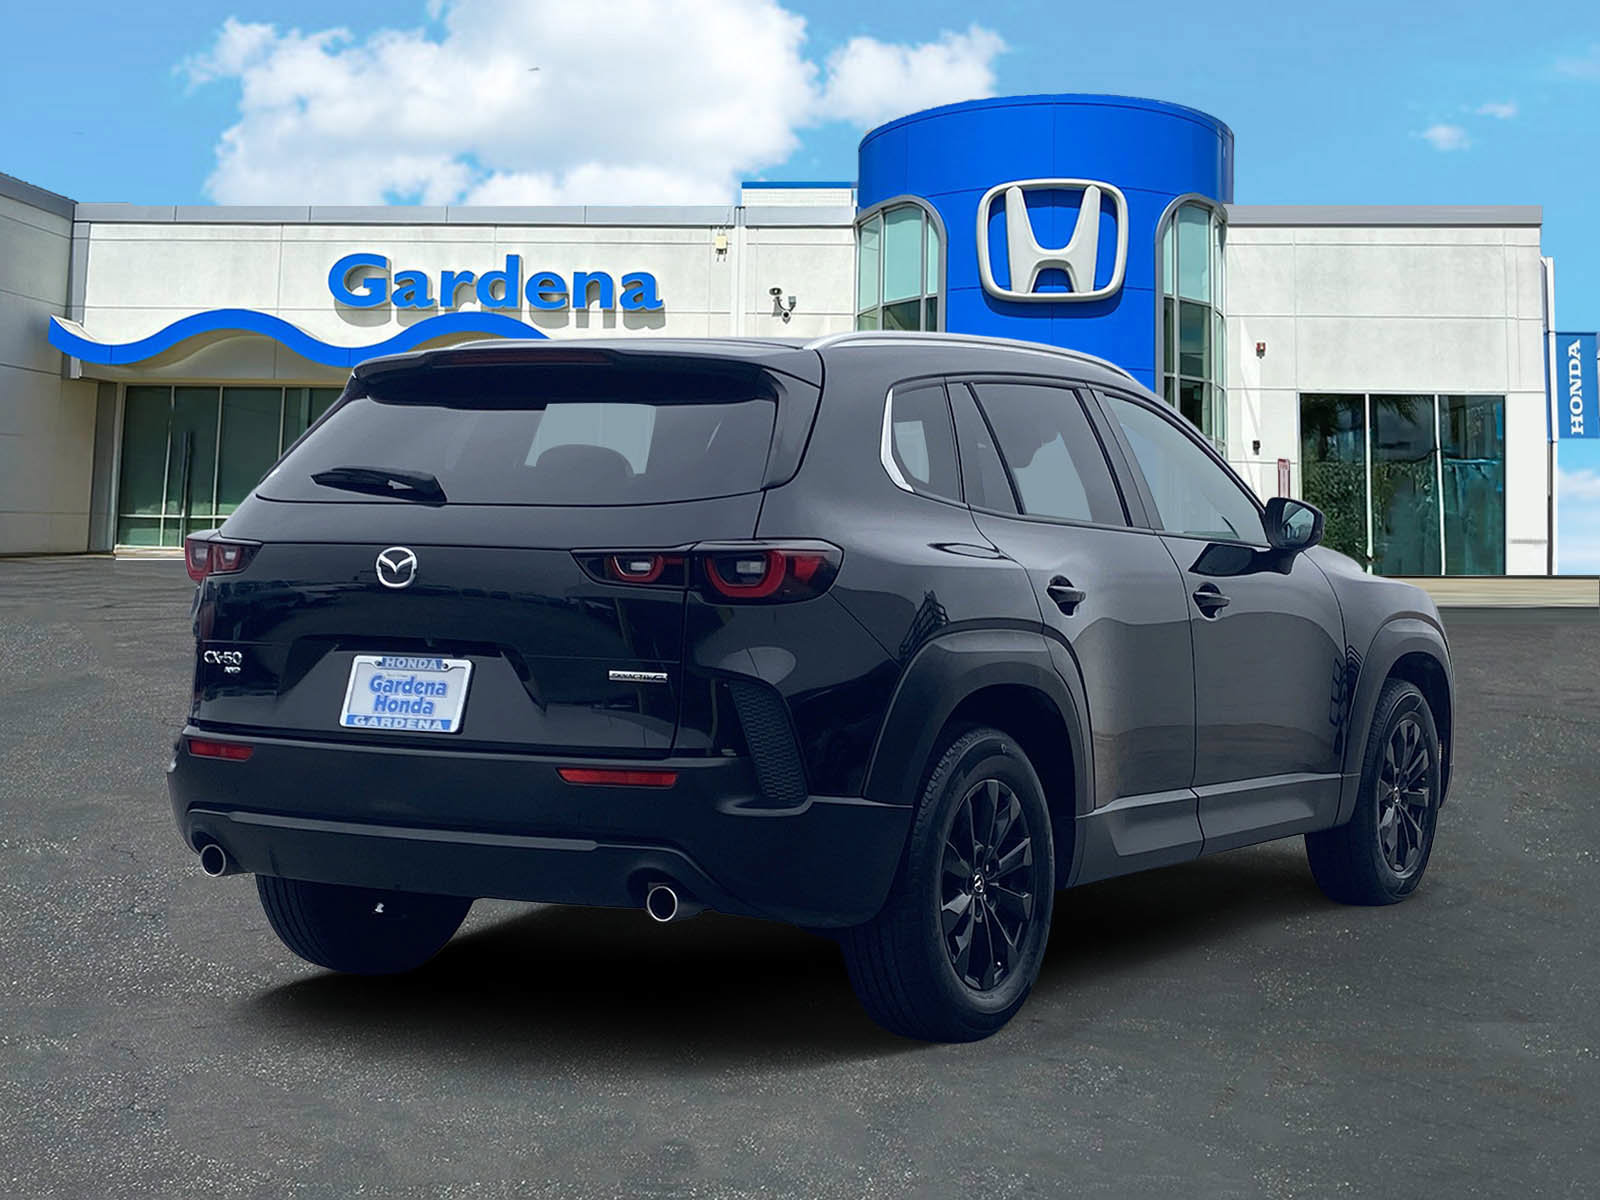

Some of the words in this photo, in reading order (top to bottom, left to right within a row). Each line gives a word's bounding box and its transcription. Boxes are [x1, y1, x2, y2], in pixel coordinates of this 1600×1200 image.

[328, 253, 664, 309] Gardena
[1568, 339, 1584, 435] HONDA
[384, 657, 438, 670] HONDA
[369, 675, 448, 697] Gardena
[374, 695, 434, 715] Honda
[353, 716, 443, 731] GARDENA
